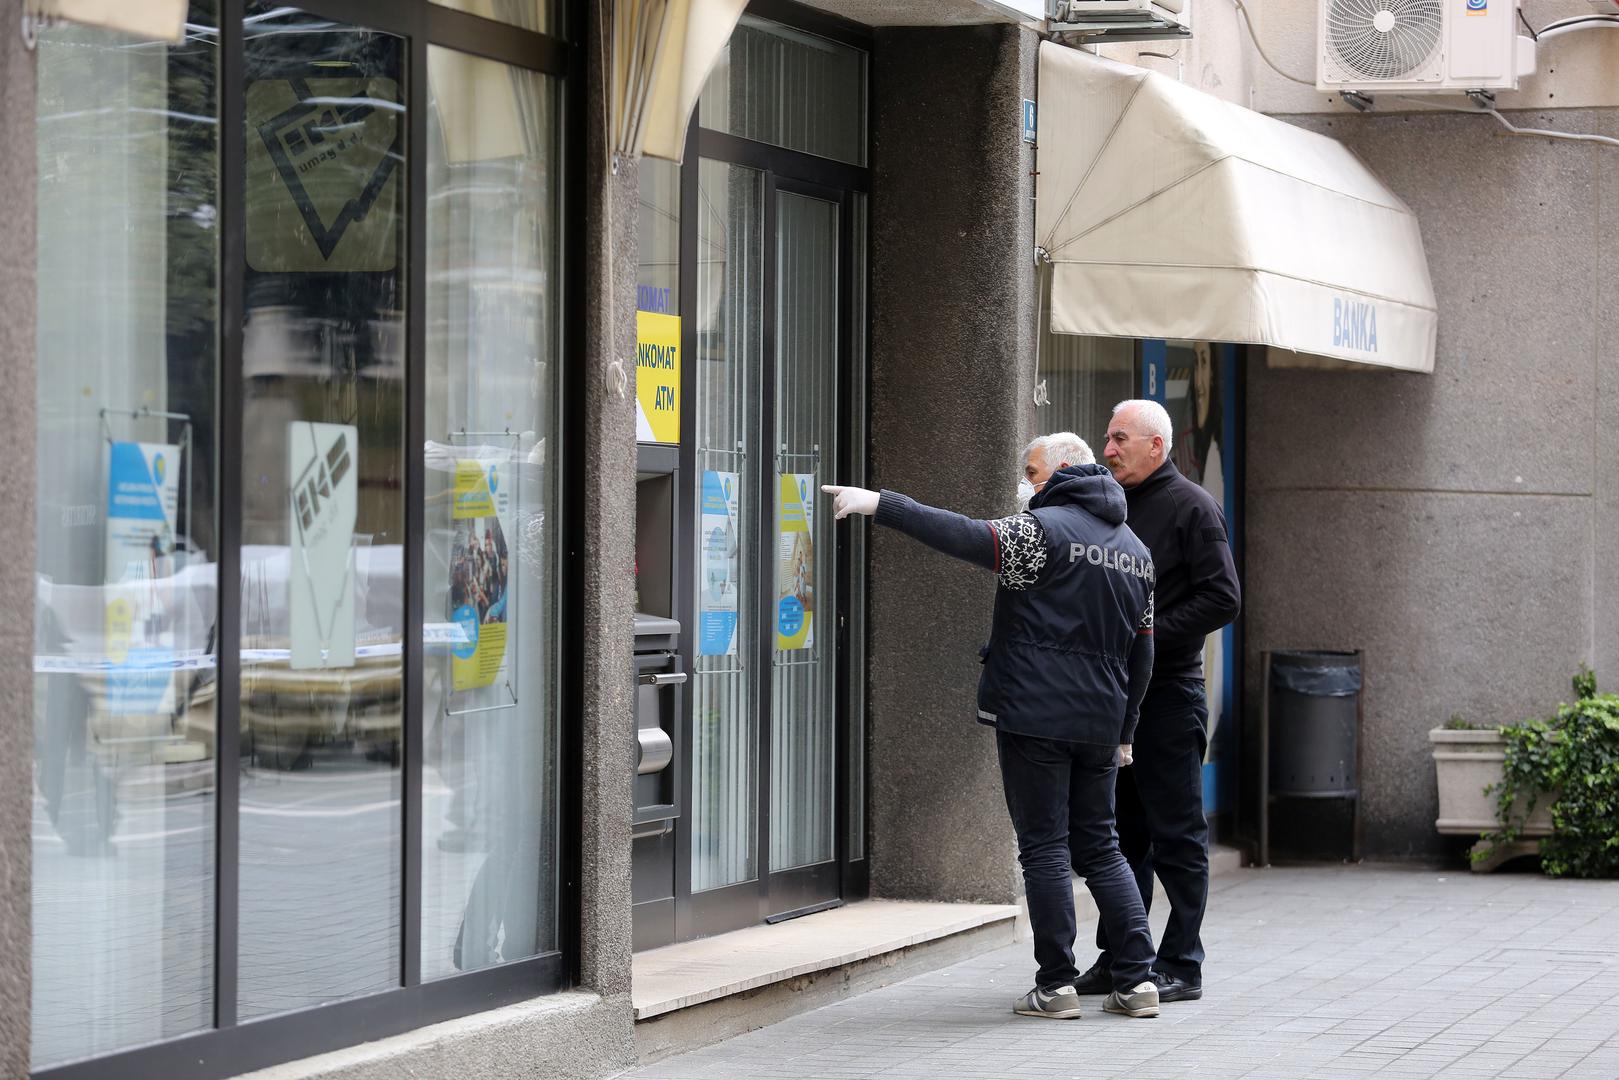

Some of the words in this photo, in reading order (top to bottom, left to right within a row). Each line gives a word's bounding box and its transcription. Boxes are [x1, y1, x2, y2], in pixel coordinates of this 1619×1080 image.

[1333, 297, 1378, 352] BANKA
[1149, 363, 1156, 395] B
[654, 385, 675, 411] ATM
[1069, 542, 1155, 583] POLICIJA
